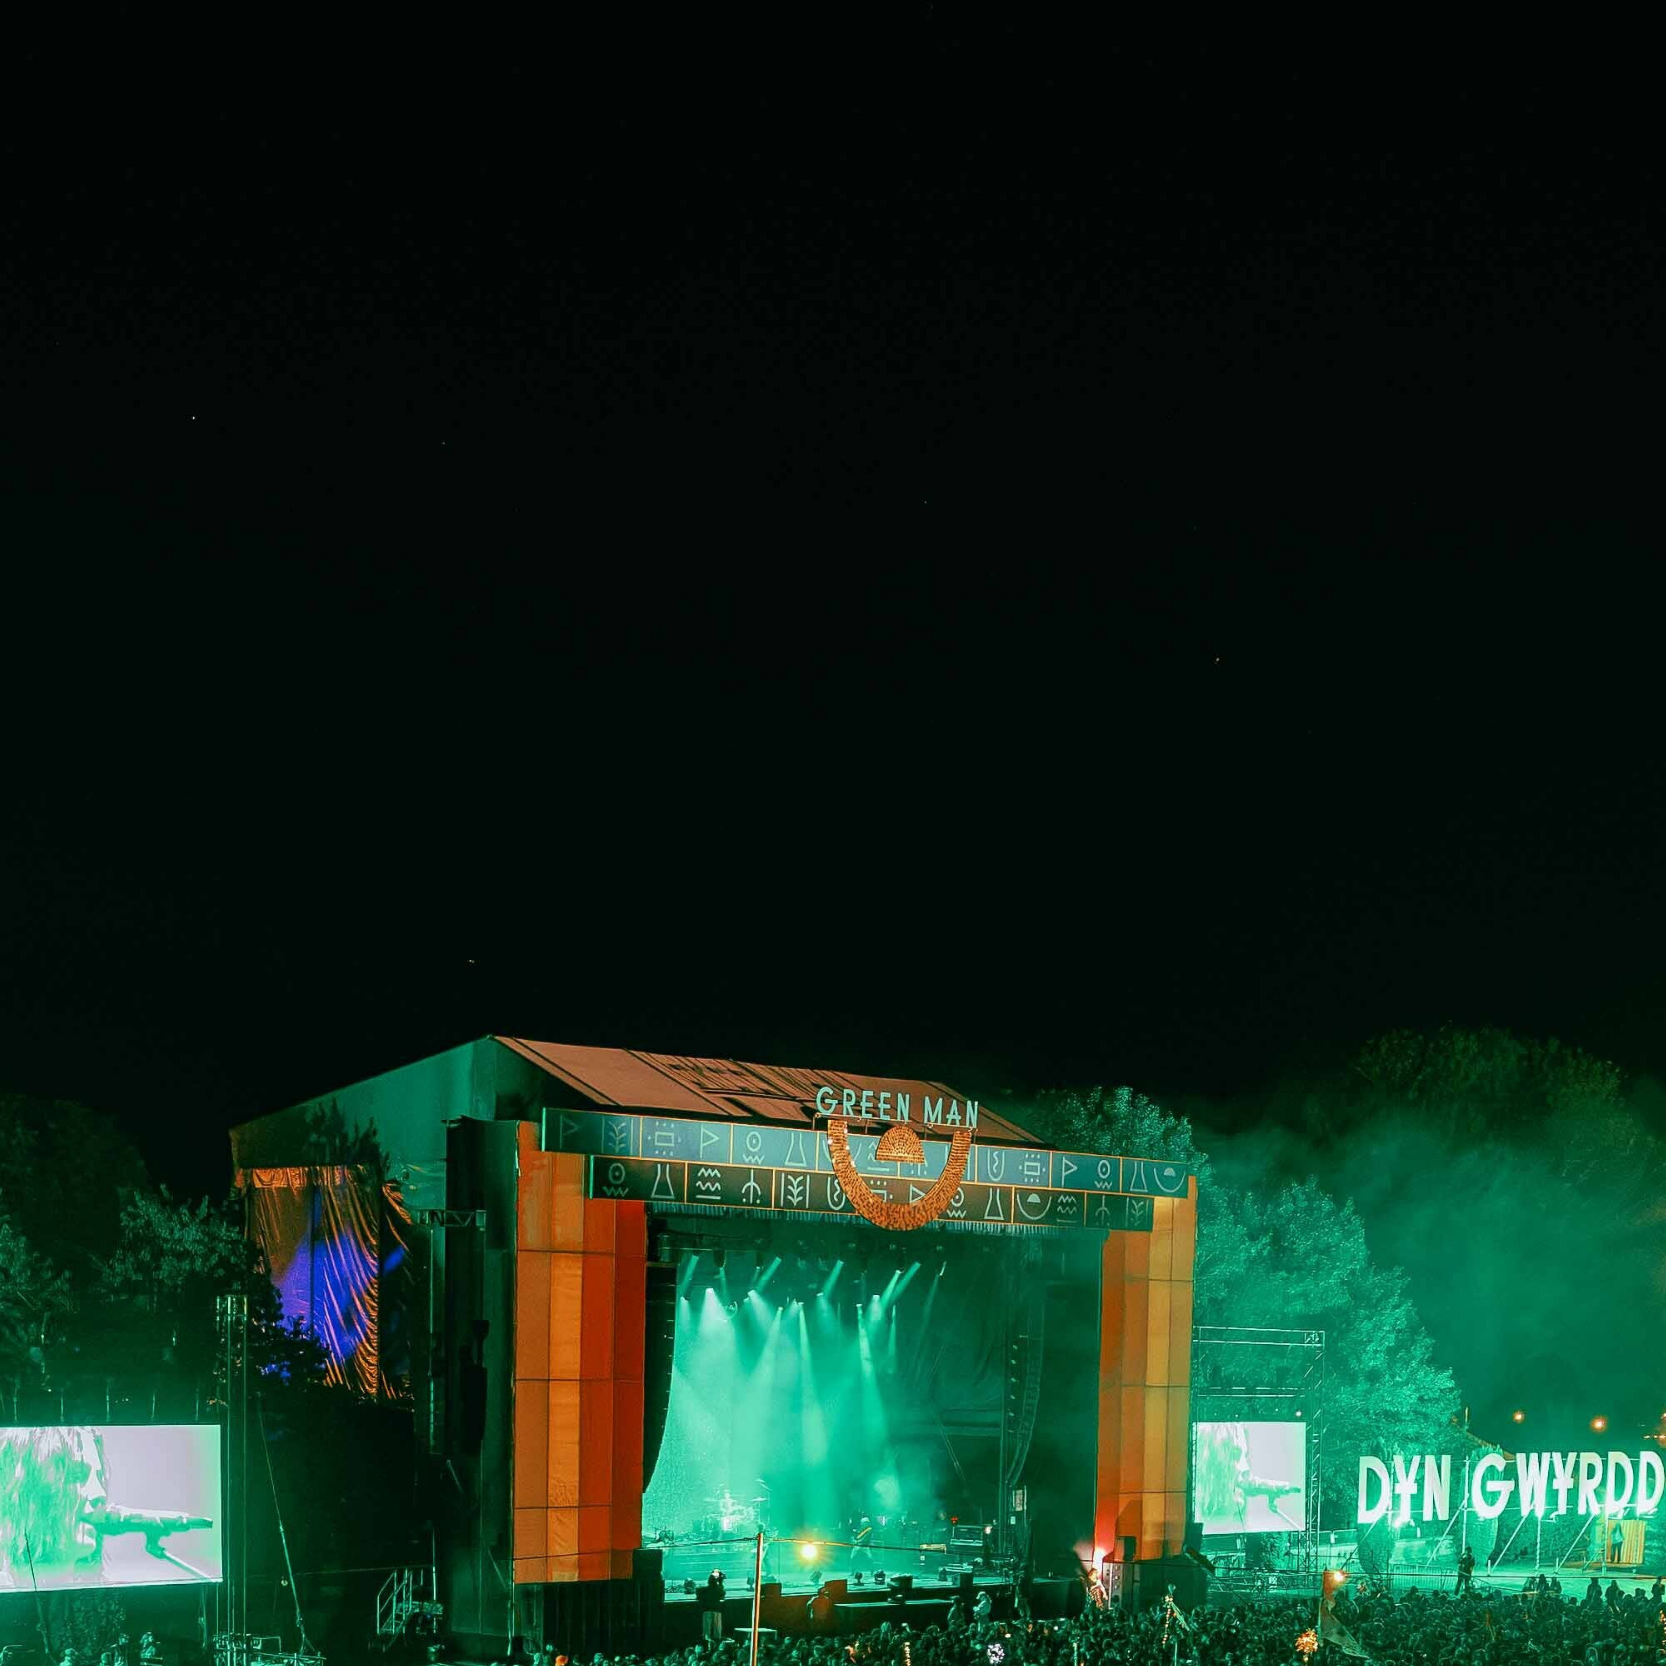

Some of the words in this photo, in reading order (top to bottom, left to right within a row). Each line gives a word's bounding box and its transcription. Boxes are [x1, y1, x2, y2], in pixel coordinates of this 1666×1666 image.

[815, 1086, 911, 1122] GREEN
[923, 1096, 979, 1129] MAN
[1357, 1453, 1452, 1524] DYN
[1471, 1450, 1666, 1520] GWYRDD
